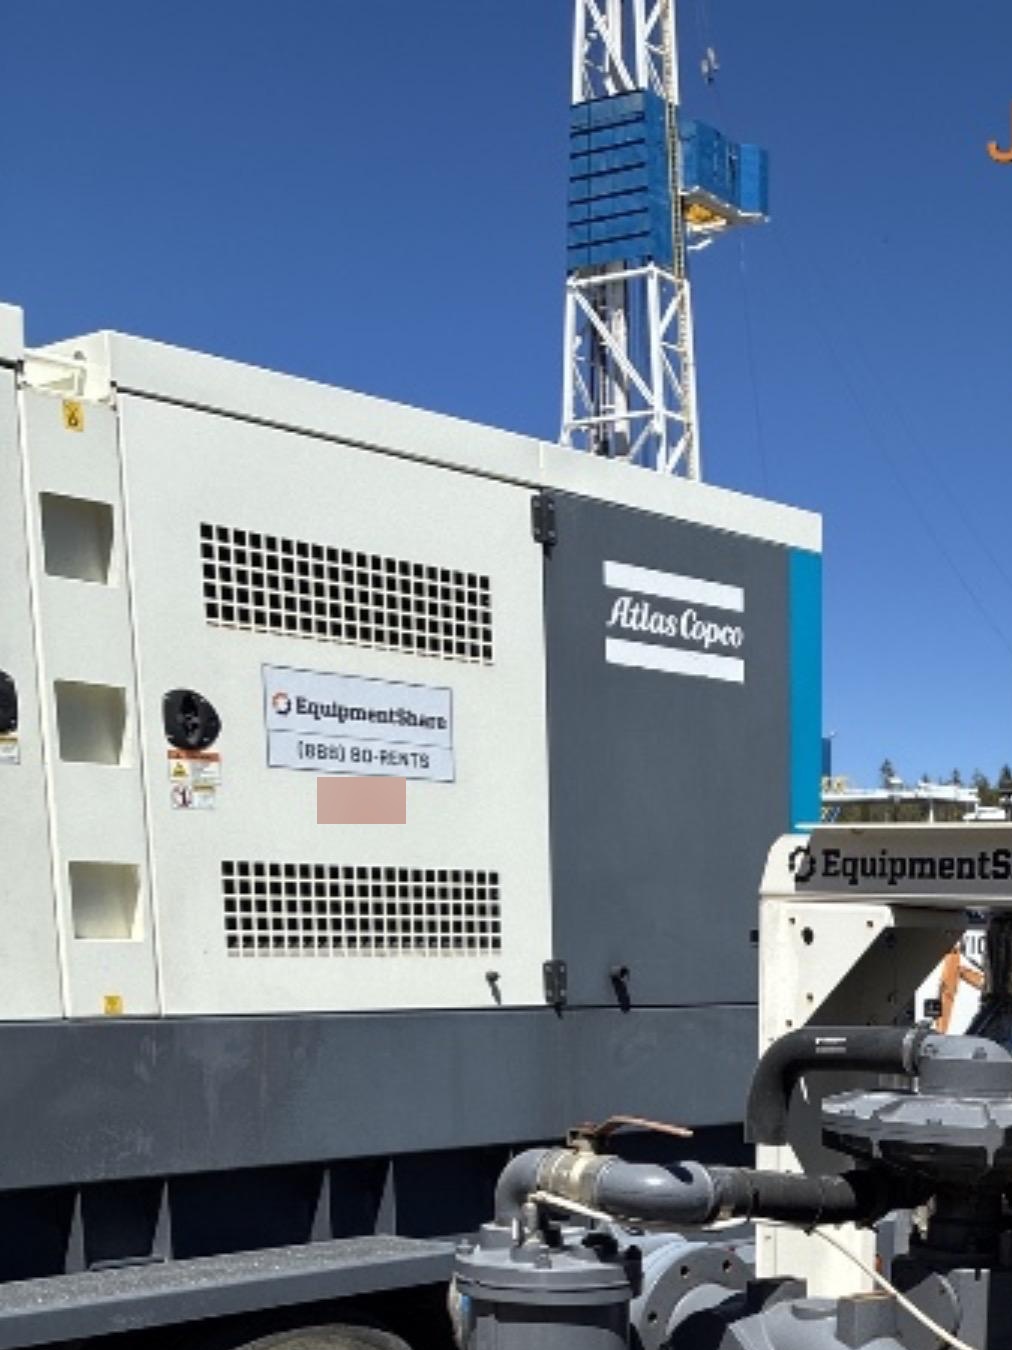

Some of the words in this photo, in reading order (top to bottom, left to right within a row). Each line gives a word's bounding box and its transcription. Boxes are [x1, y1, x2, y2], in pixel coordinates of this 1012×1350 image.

[606, 596, 679, 638] Atlas
[680, 608, 745, 649] Copco
[295, 696, 448, 730] EquipmentShare
